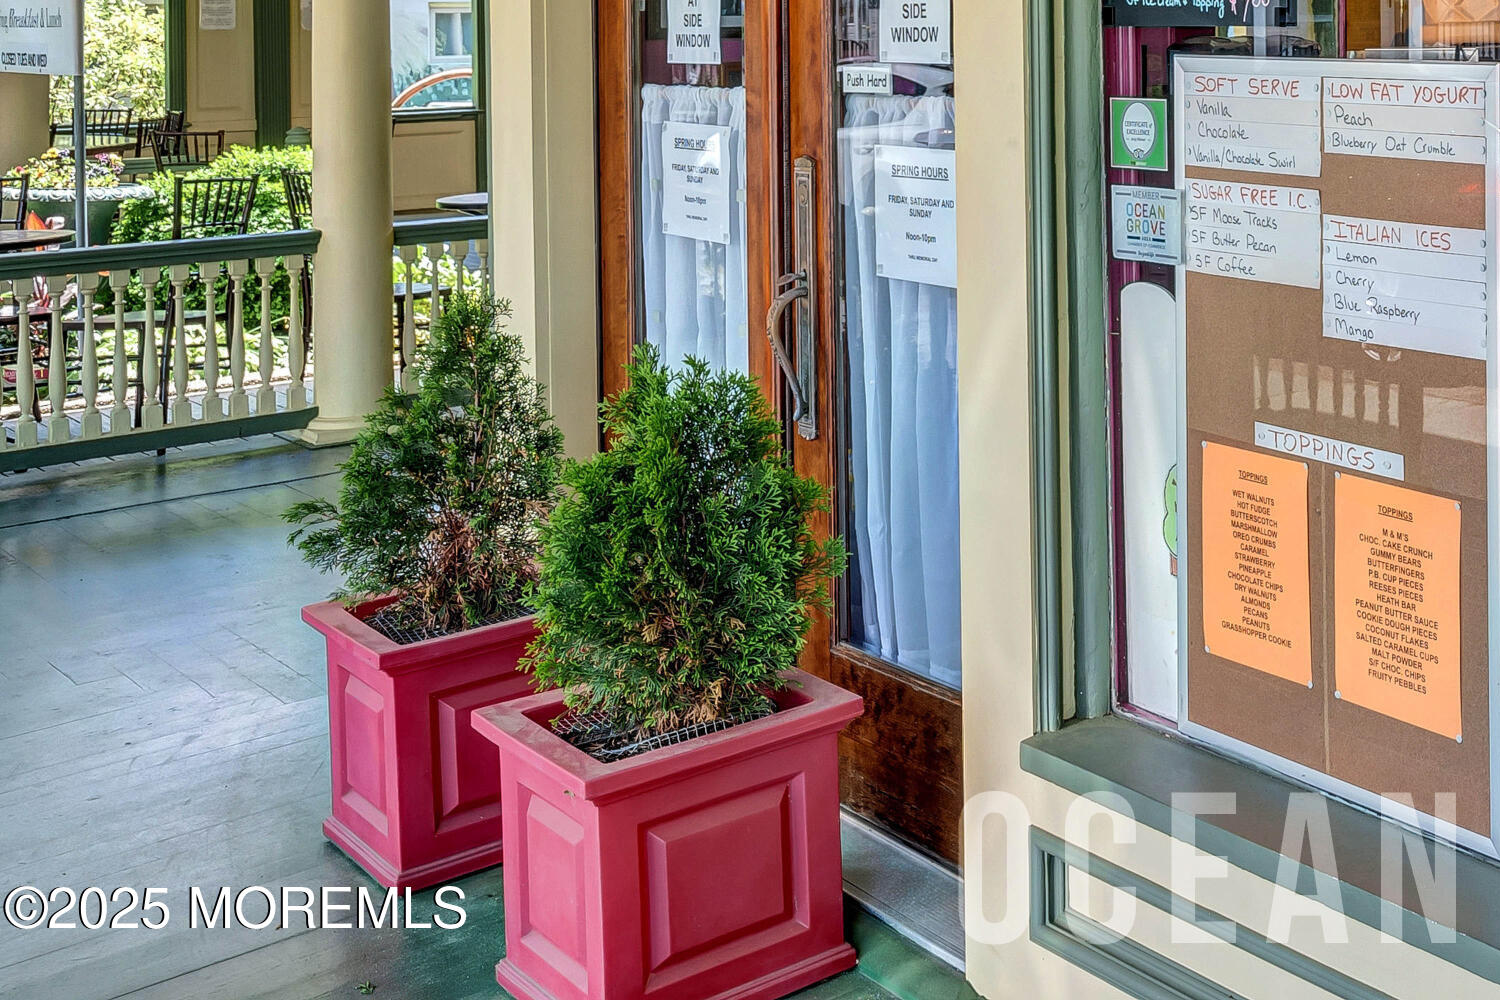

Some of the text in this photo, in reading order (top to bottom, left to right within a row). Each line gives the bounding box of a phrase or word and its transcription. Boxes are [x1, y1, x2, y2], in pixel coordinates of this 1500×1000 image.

[902, 3, 927, 19] SIDE
[683, 14, 702, 28] SIDE
[676, 34, 711, 48] WINDOW
[891, 27, 939, 43] WINDOW
[846, 73, 887, 88] Push Hard
[1195, 76, 1300, 98] SOFT SERVE
[1330, 83, 1483, 105] LOW FAT YOGURT
[1196, 99, 1232, 118] Vanilla
[1334, 105, 1373, 127] Peach
[1197, 122, 1249, 140] Chocolate
[1332, 132, 1456, 157] Blueberry Oat Crumble
[891, 165, 949, 179] SPRING HOURS
[910, 197, 940, 207] SATURDAY
[942, 199, 954, 208] AND
[1133, 191, 1159, 200] MEMBER
[1192, 182, 1312, 210] SUGAR FREE I.C.
[909, 209, 932, 218] SUNDAY
[1126, 203, 1165, 219] OCEAN
[1190, 206, 1277, 230] SF Moose Tracks
[1127, 219, 1165, 236] GROVE
[1333, 220, 1451, 251] ITALIAN ICES
[1335, 246, 1377, 266] Lemon
[1336, 270, 1374, 292] Cherry
[1335, 319, 1374, 340] Mango
[1268, 429, 1375, 471] TOPPINGS
[1238, 470, 1268, 484] TOPPINGS
[1231, 509, 1278, 528] BUTTERSCOTCH
[1378, 505, 1413, 520] TOPPINGS
[1231, 520, 1278, 538] MARSHMALLOW
[1240, 543, 1269, 557] CARAMEL
[1370, 548, 1421, 568] GUMMY BEARS
[1239, 563, 1272, 579] PINEAPPLE
[1368, 558, 1424, 580] BUTTERFINGERS
[1241, 595, 1270, 610] ALMONDS
[1356, 599, 1438, 630] PEANUT BUTTER SAUCE
[1366, 624, 1429, 649] COCONUT FLAKES
[1372, 648, 1422, 670] MALT POWDER
